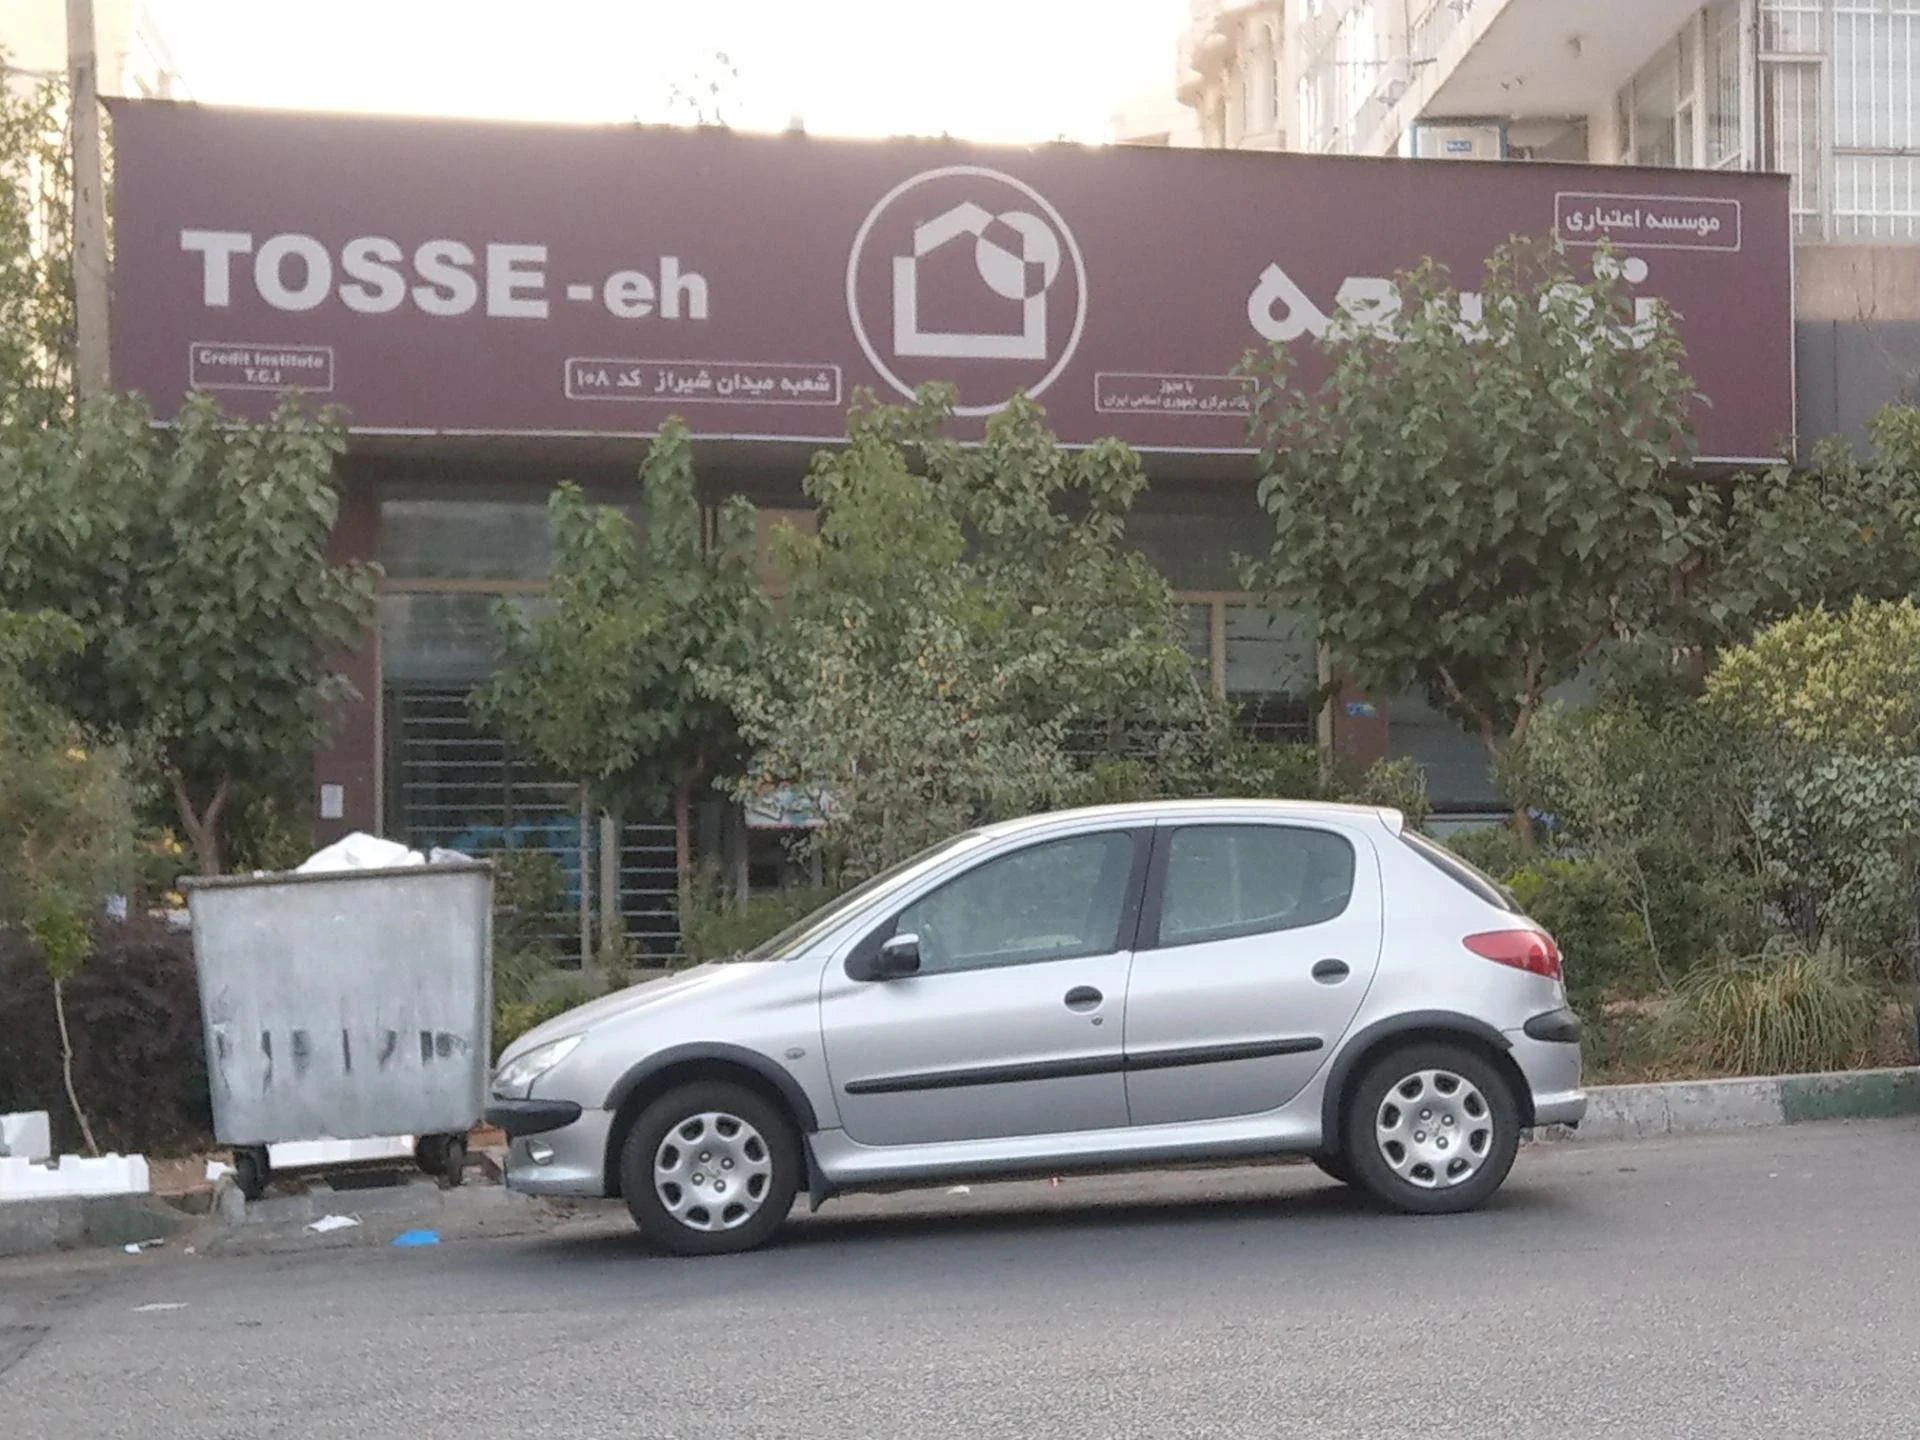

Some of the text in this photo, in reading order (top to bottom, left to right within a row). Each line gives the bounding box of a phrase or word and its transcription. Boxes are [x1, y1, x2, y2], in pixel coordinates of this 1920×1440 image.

[1566, 206, 1721, 236] موسسه اعتباری
[200, 349, 324, 369] Credit Institute
[577, 368, 830, 396] شعبه میدان شیراز کد ۱۰۸
